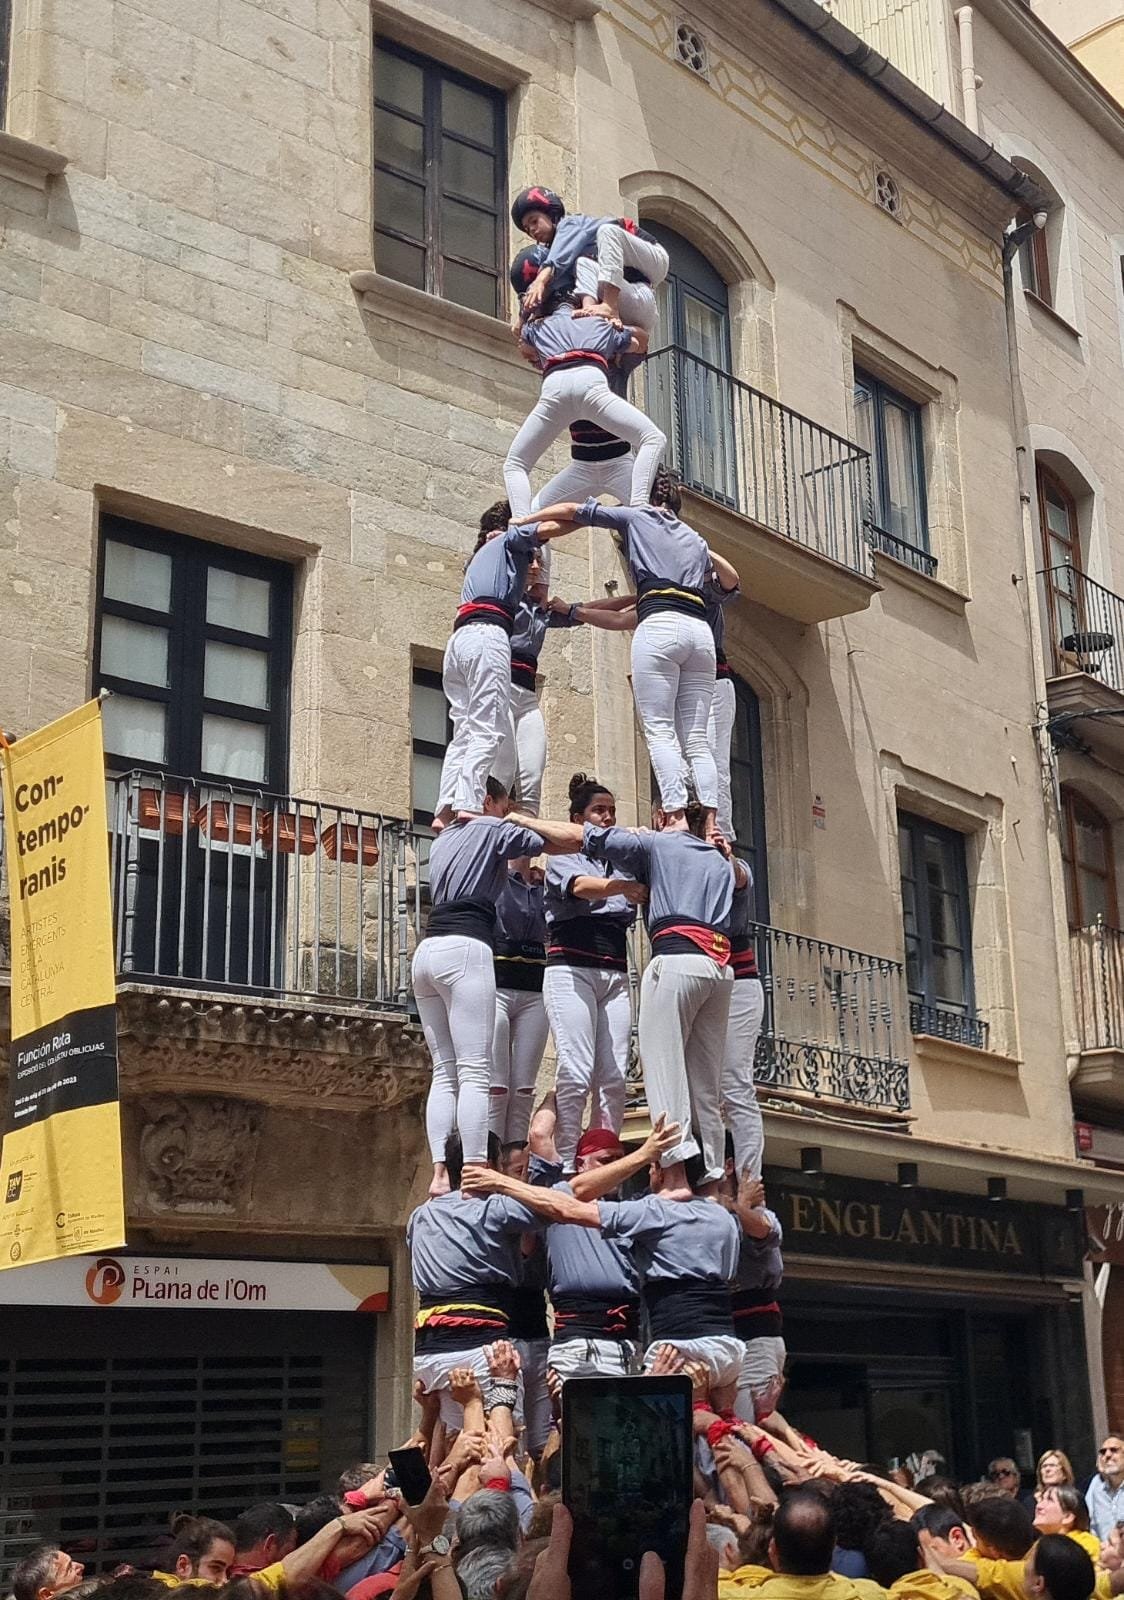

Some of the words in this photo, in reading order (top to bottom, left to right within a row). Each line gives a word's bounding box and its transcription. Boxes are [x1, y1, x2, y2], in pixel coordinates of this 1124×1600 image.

[15, 775, 64, 812] Con-
[17, 804, 90, 856] tempo-
[19, 855, 67, 900] ranis
[17, 1041, 51, 1067] Función
[133, 1265, 179, 1276] ESPAI
[196, 1278, 220, 1301] de
[225, 1278, 267, 1302] l'Om
